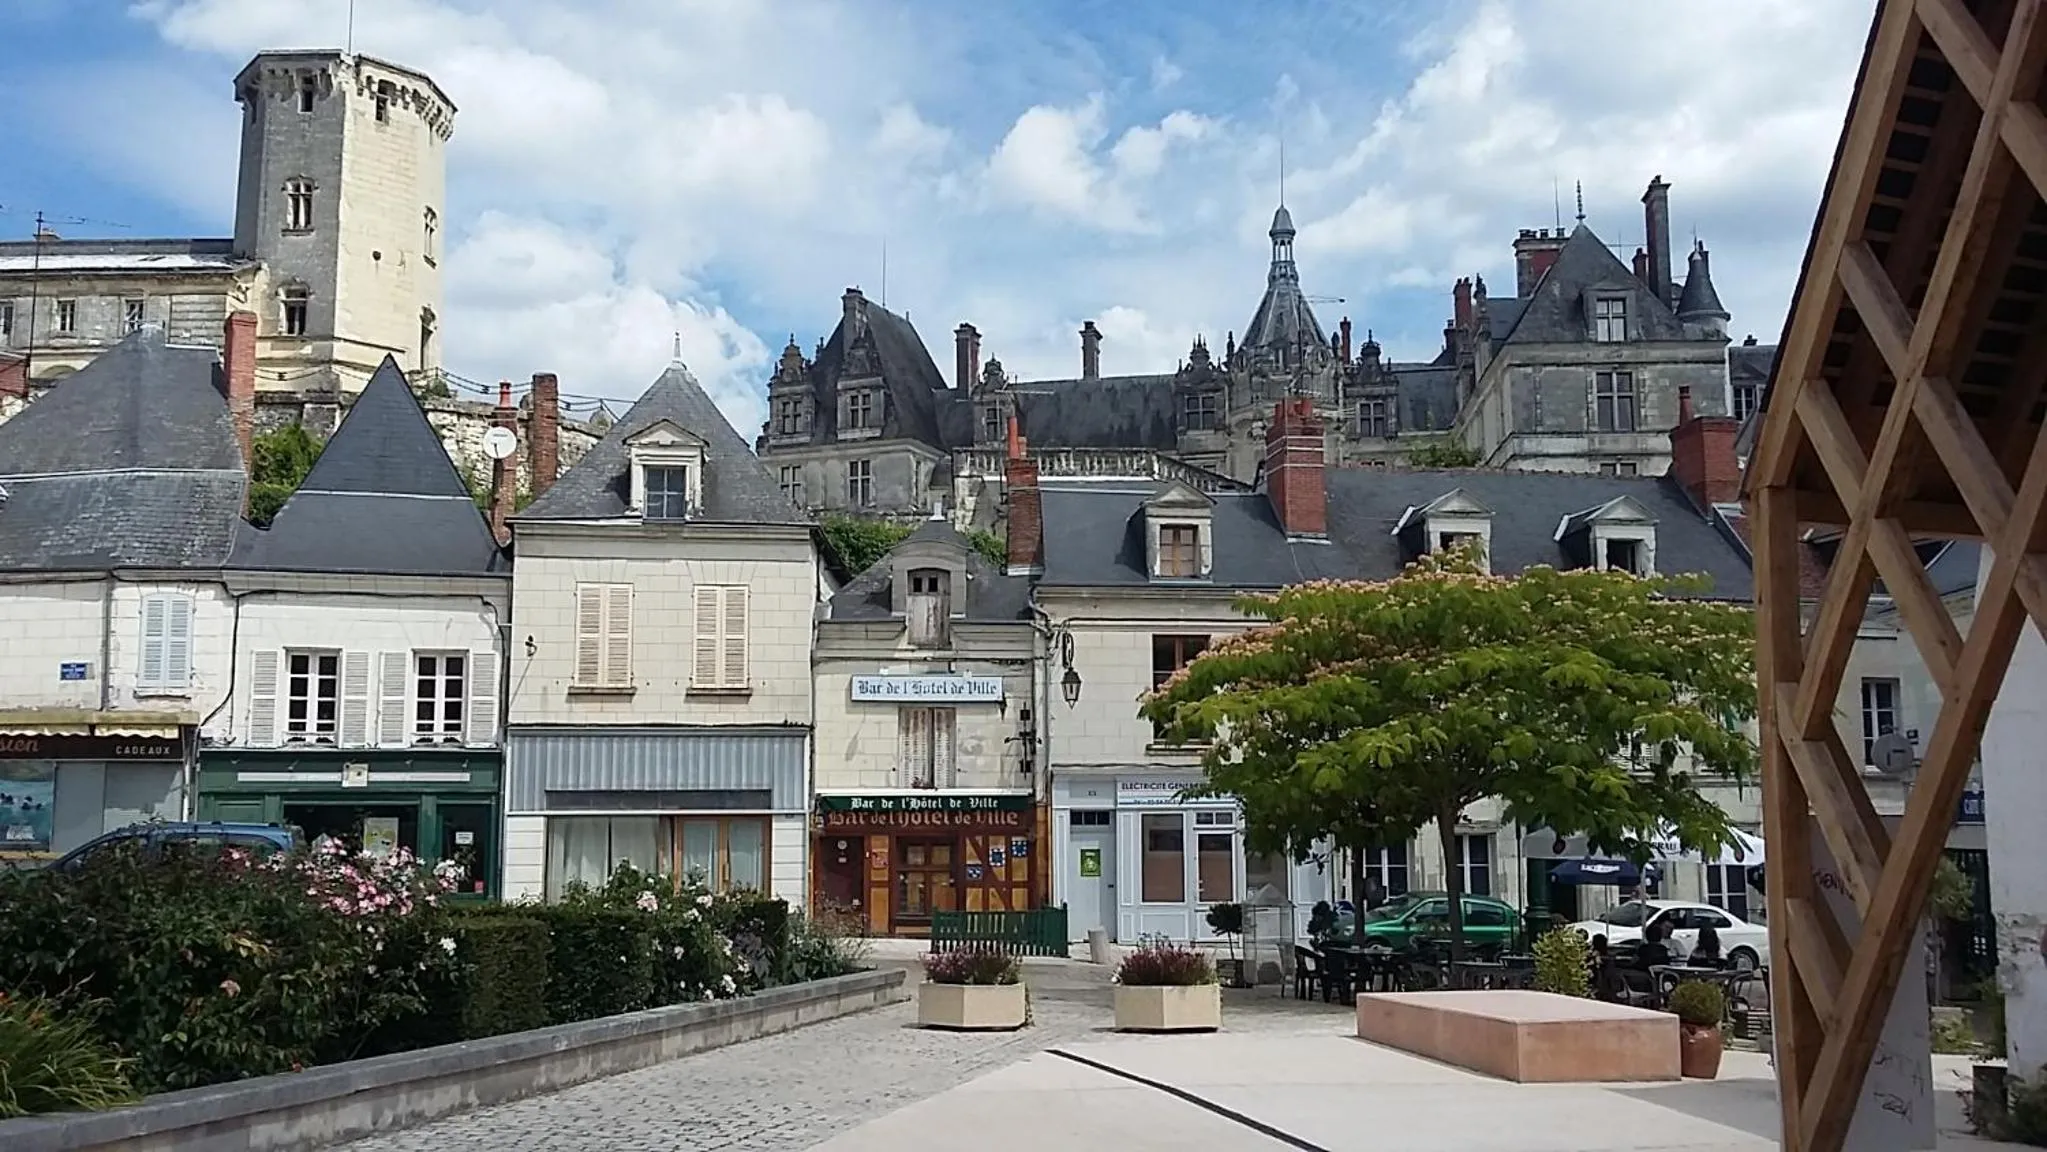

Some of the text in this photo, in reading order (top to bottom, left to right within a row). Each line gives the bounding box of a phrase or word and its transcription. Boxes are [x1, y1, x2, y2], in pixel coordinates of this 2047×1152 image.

[858, 680, 881, 695] Bar
[886, 681, 901, 695] de
[950, 681, 964, 695] de
[967, 681, 997, 695] Ville
[115, 745, 170, 755] CADEAUX
[851, 797, 875, 809] Bar
[881, 798, 894, 809] de
[949, 797, 962, 808] de
[968, 797, 999, 808] Ville
